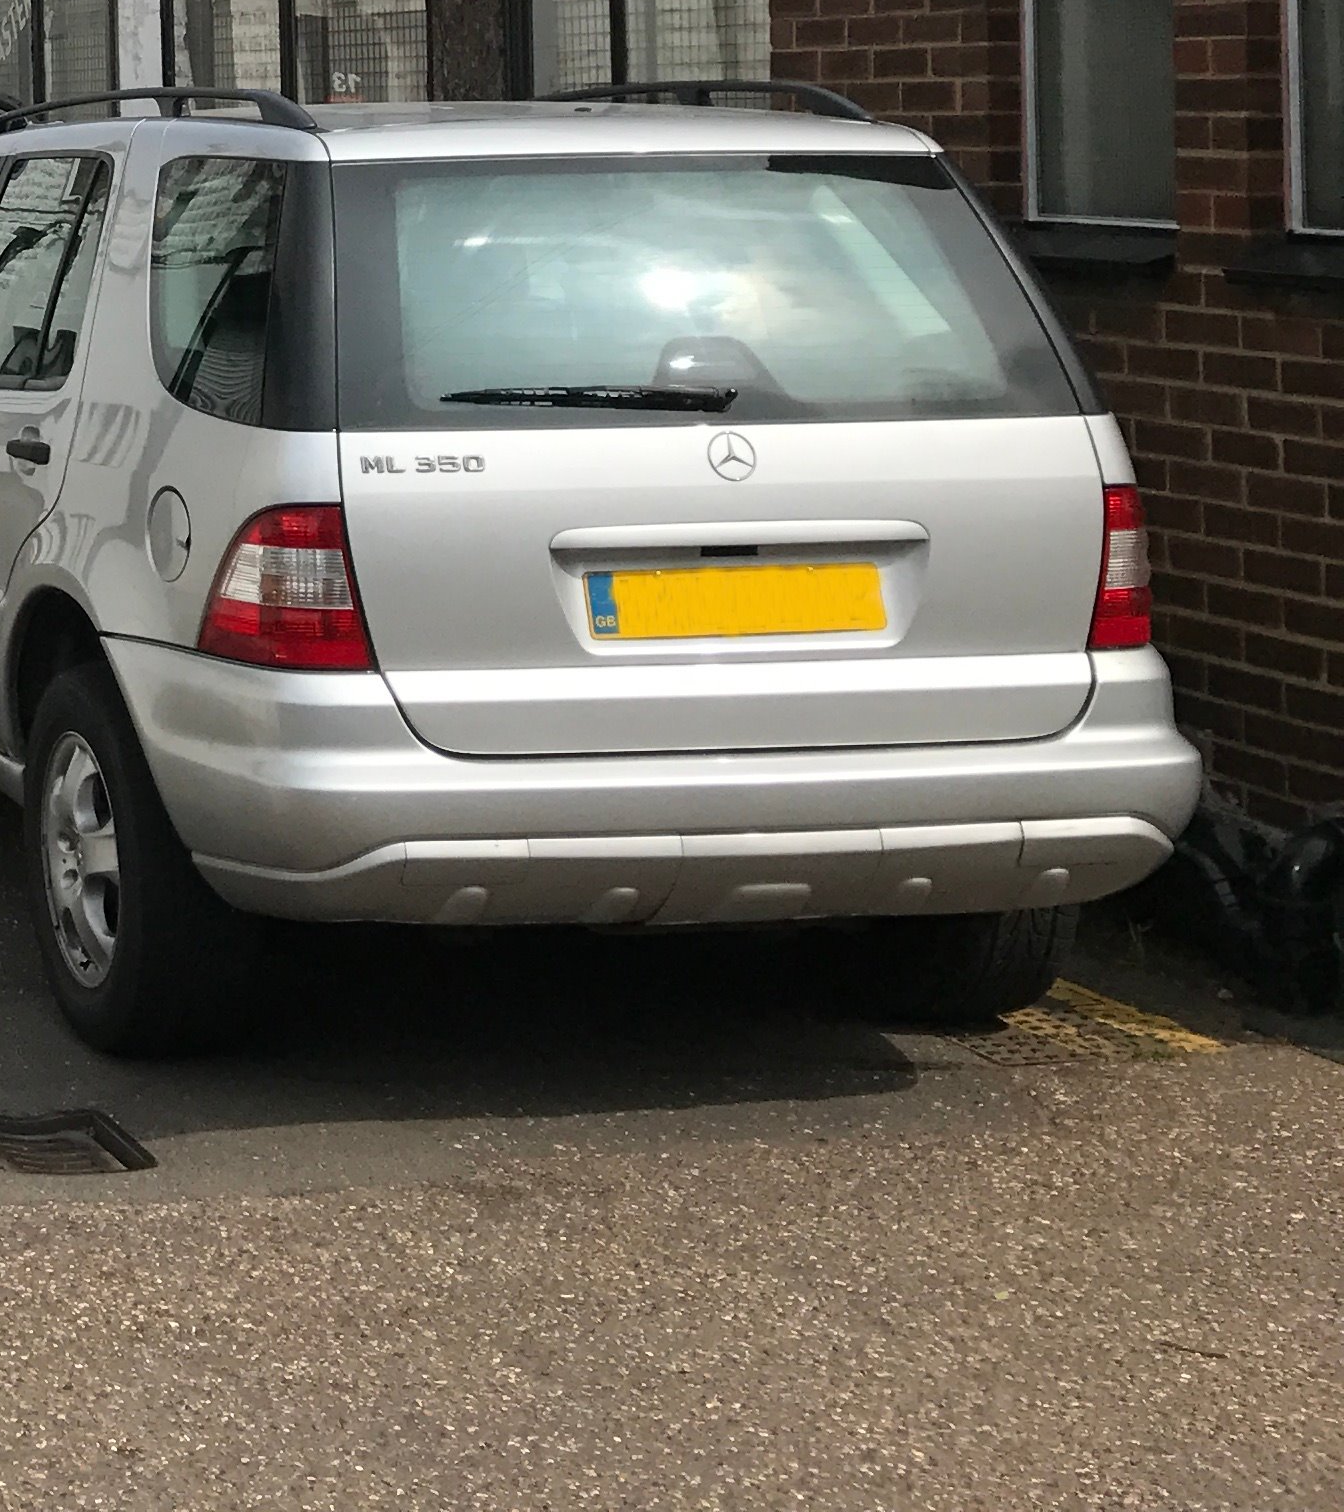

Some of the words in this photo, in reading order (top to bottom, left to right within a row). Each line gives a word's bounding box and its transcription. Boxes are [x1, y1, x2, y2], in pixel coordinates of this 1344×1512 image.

[359, 455, 406, 474] ML
[414, 454, 486, 473] 350
[595, 615, 616, 628] GB
